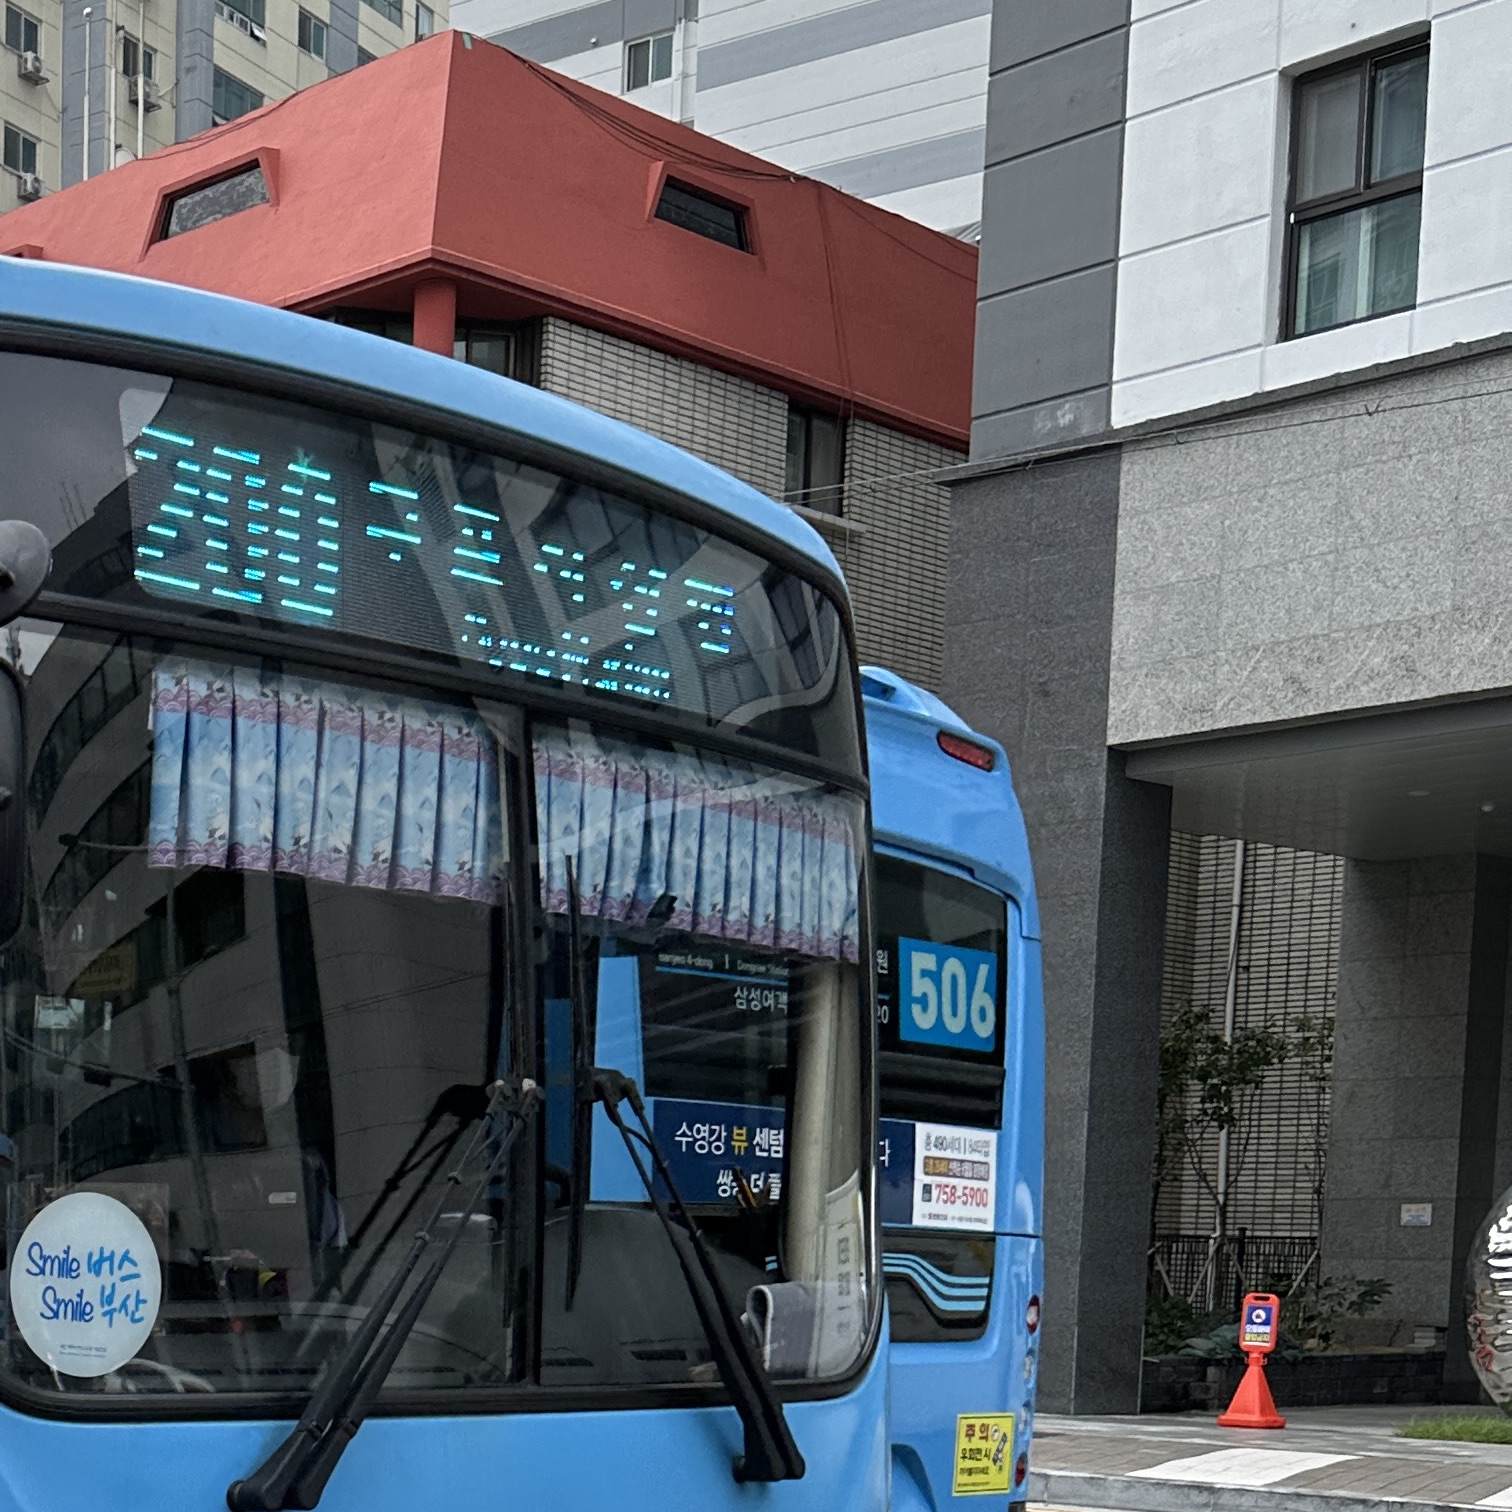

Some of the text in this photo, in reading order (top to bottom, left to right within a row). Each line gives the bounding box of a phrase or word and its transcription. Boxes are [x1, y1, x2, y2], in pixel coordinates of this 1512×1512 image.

[134, 426, 339, 616] 200
[733, 986, 788, 1014] 삼성여객
[911, 951, 996, 1039] 506
[674, 1121, 727, 1155] 수영강
[731, 1125, 748, 1156] 뷰
[752, 1127, 785, 1158] 센텀
[934, 1183, 989, 1208] 758-5900
[25, 1241, 142, 1283] Smile 버스
[40, 1281, 148, 1329] Smile 부산
